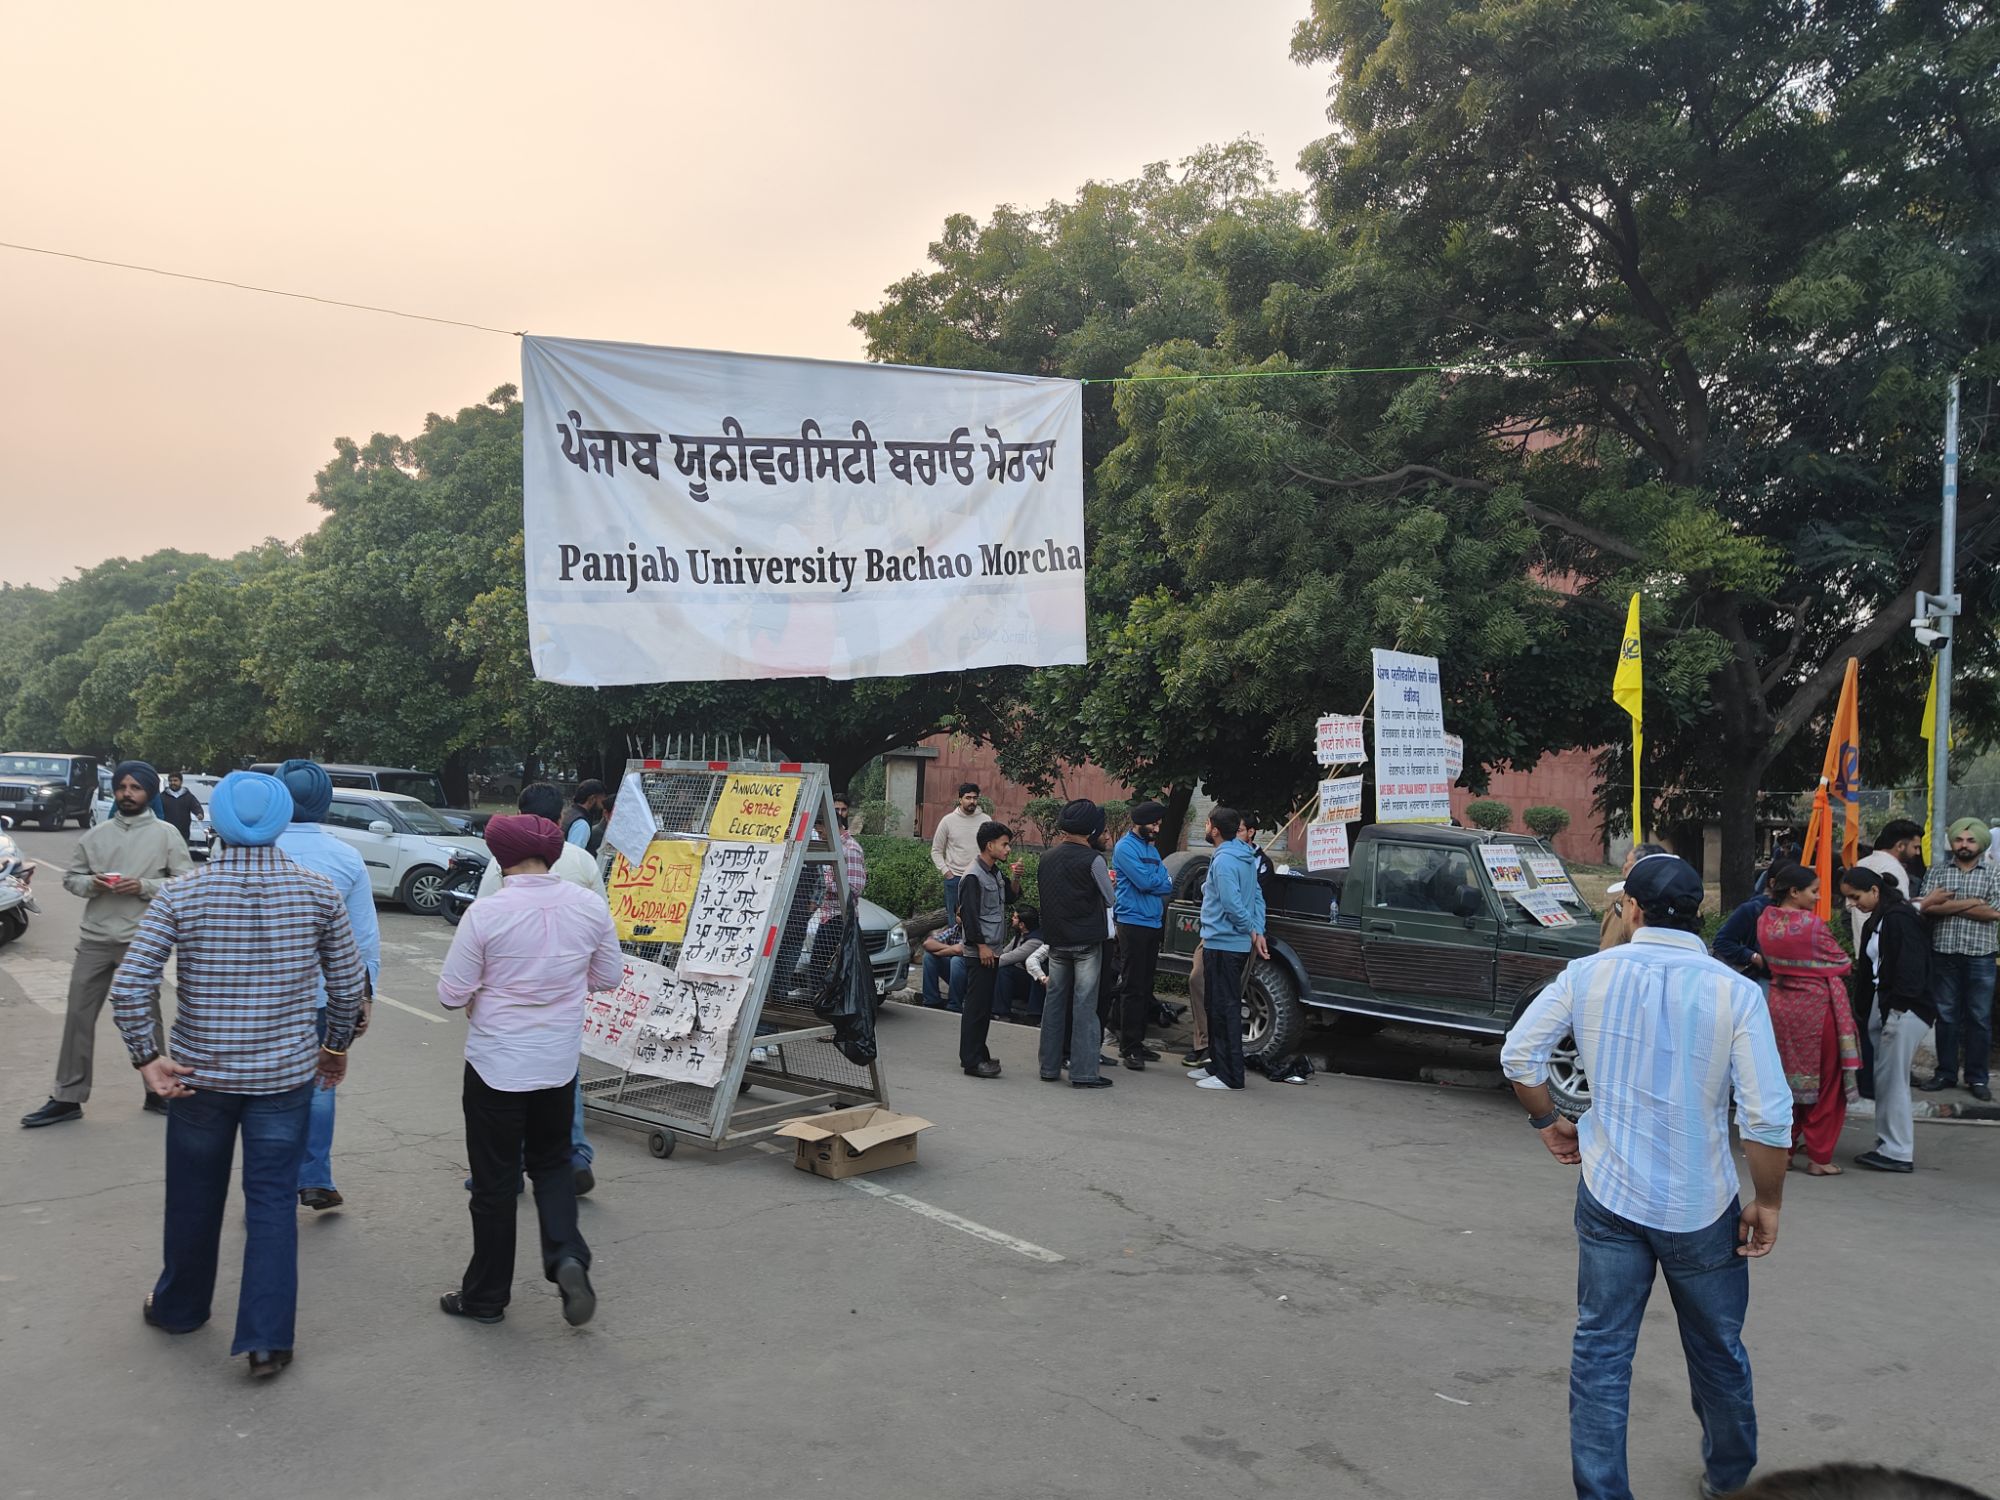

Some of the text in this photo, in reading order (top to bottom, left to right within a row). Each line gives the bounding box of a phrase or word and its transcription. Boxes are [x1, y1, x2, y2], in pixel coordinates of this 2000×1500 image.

[556, 410, 1057, 503] ਪੰਜਾਬ ਯੂਨੀਵਰਸਿਟੀ ਬਚਾਓ ਮੋਰਚਾ
[558, 539, 1083, 593] Panjab University Bachao Morcha
[730, 779, 784, 797] ANNOUNCE
[740, 799, 782, 817] Senate
